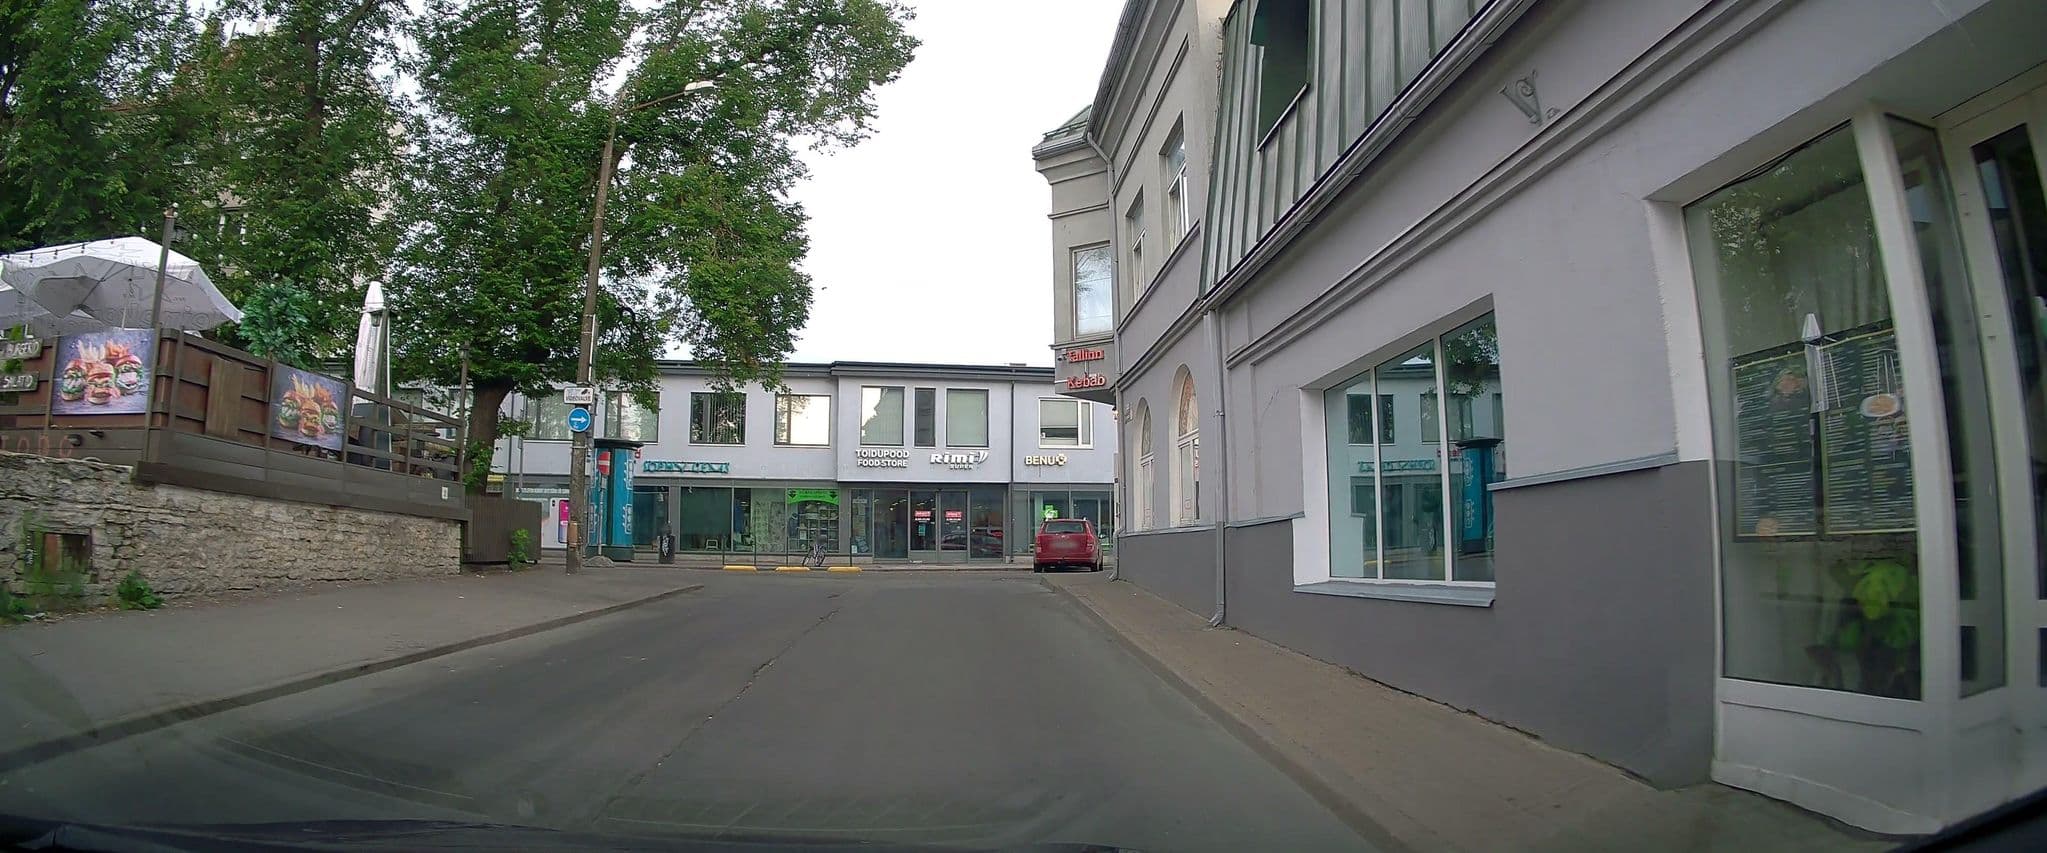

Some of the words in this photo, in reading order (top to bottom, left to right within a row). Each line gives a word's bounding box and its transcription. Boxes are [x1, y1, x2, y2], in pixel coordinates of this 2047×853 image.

[1068, 349, 1104, 362] Tallinn
[1067, 373, 1106, 389] Kebab
[857, 459, 880, 468] FOOD
[880, 459, 908, 469] STORE
[1024, 455, 1055, 466] BENU
